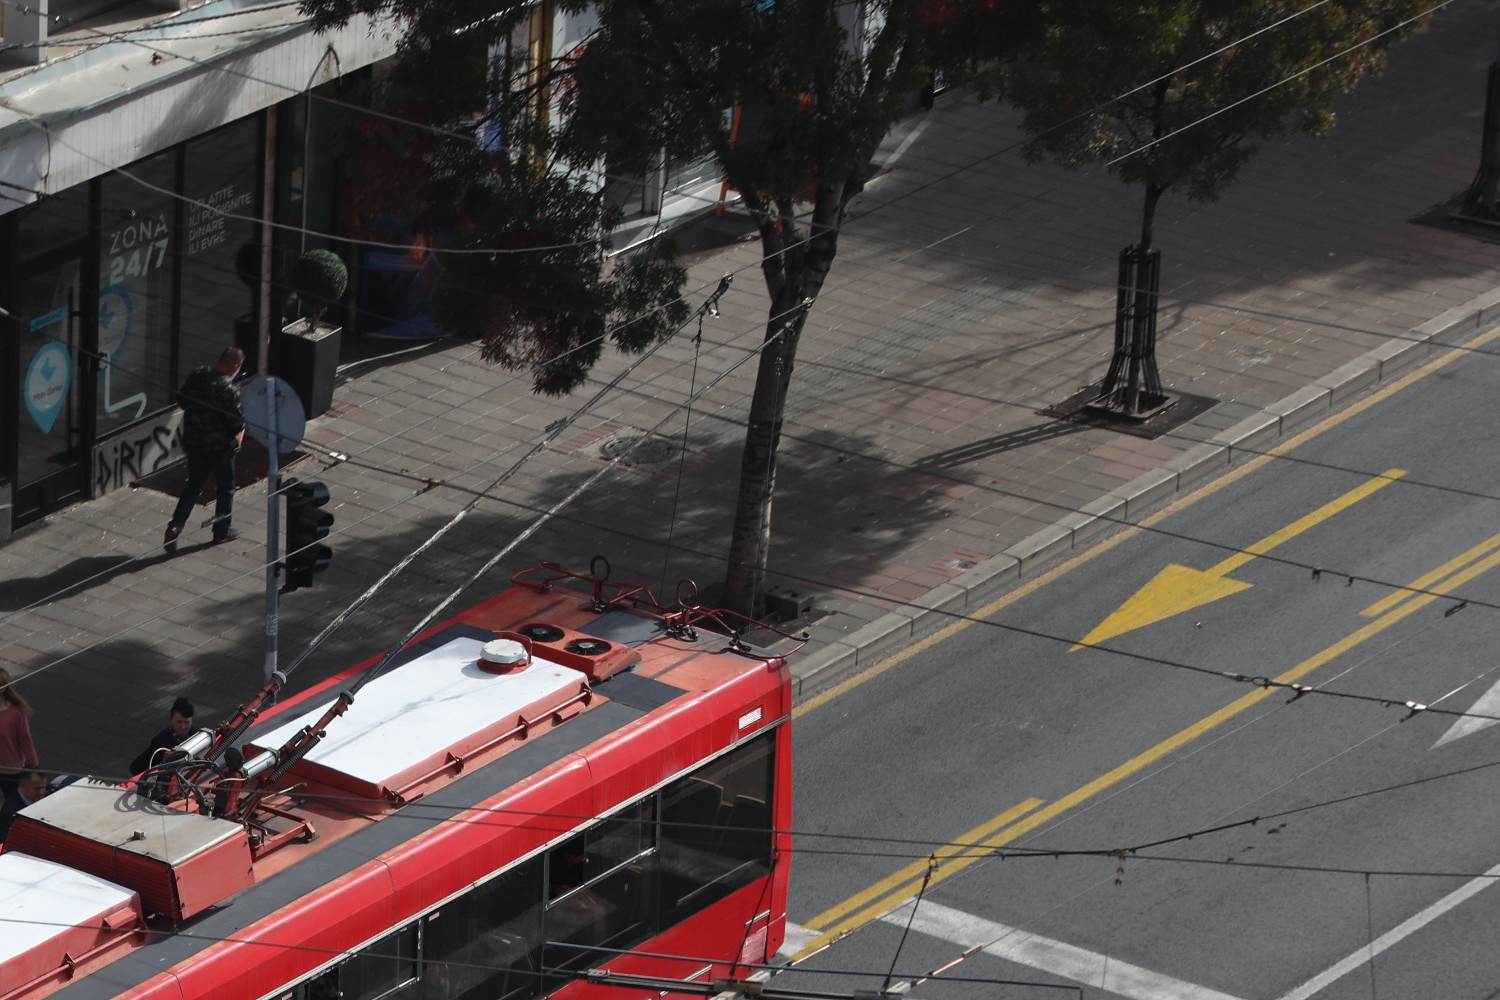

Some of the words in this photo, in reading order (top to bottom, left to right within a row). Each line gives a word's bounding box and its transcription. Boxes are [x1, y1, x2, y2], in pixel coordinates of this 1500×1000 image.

[189, 185, 235, 213] UPLATITE
[109, 213, 168, 255] ZONA
[188, 213, 201, 228] ILI
[188, 217, 225, 242] DINARE
[188, 241, 201, 256] ILI
[201, 230, 227, 252] EVRE
[109, 238, 169, 286] 24/7
